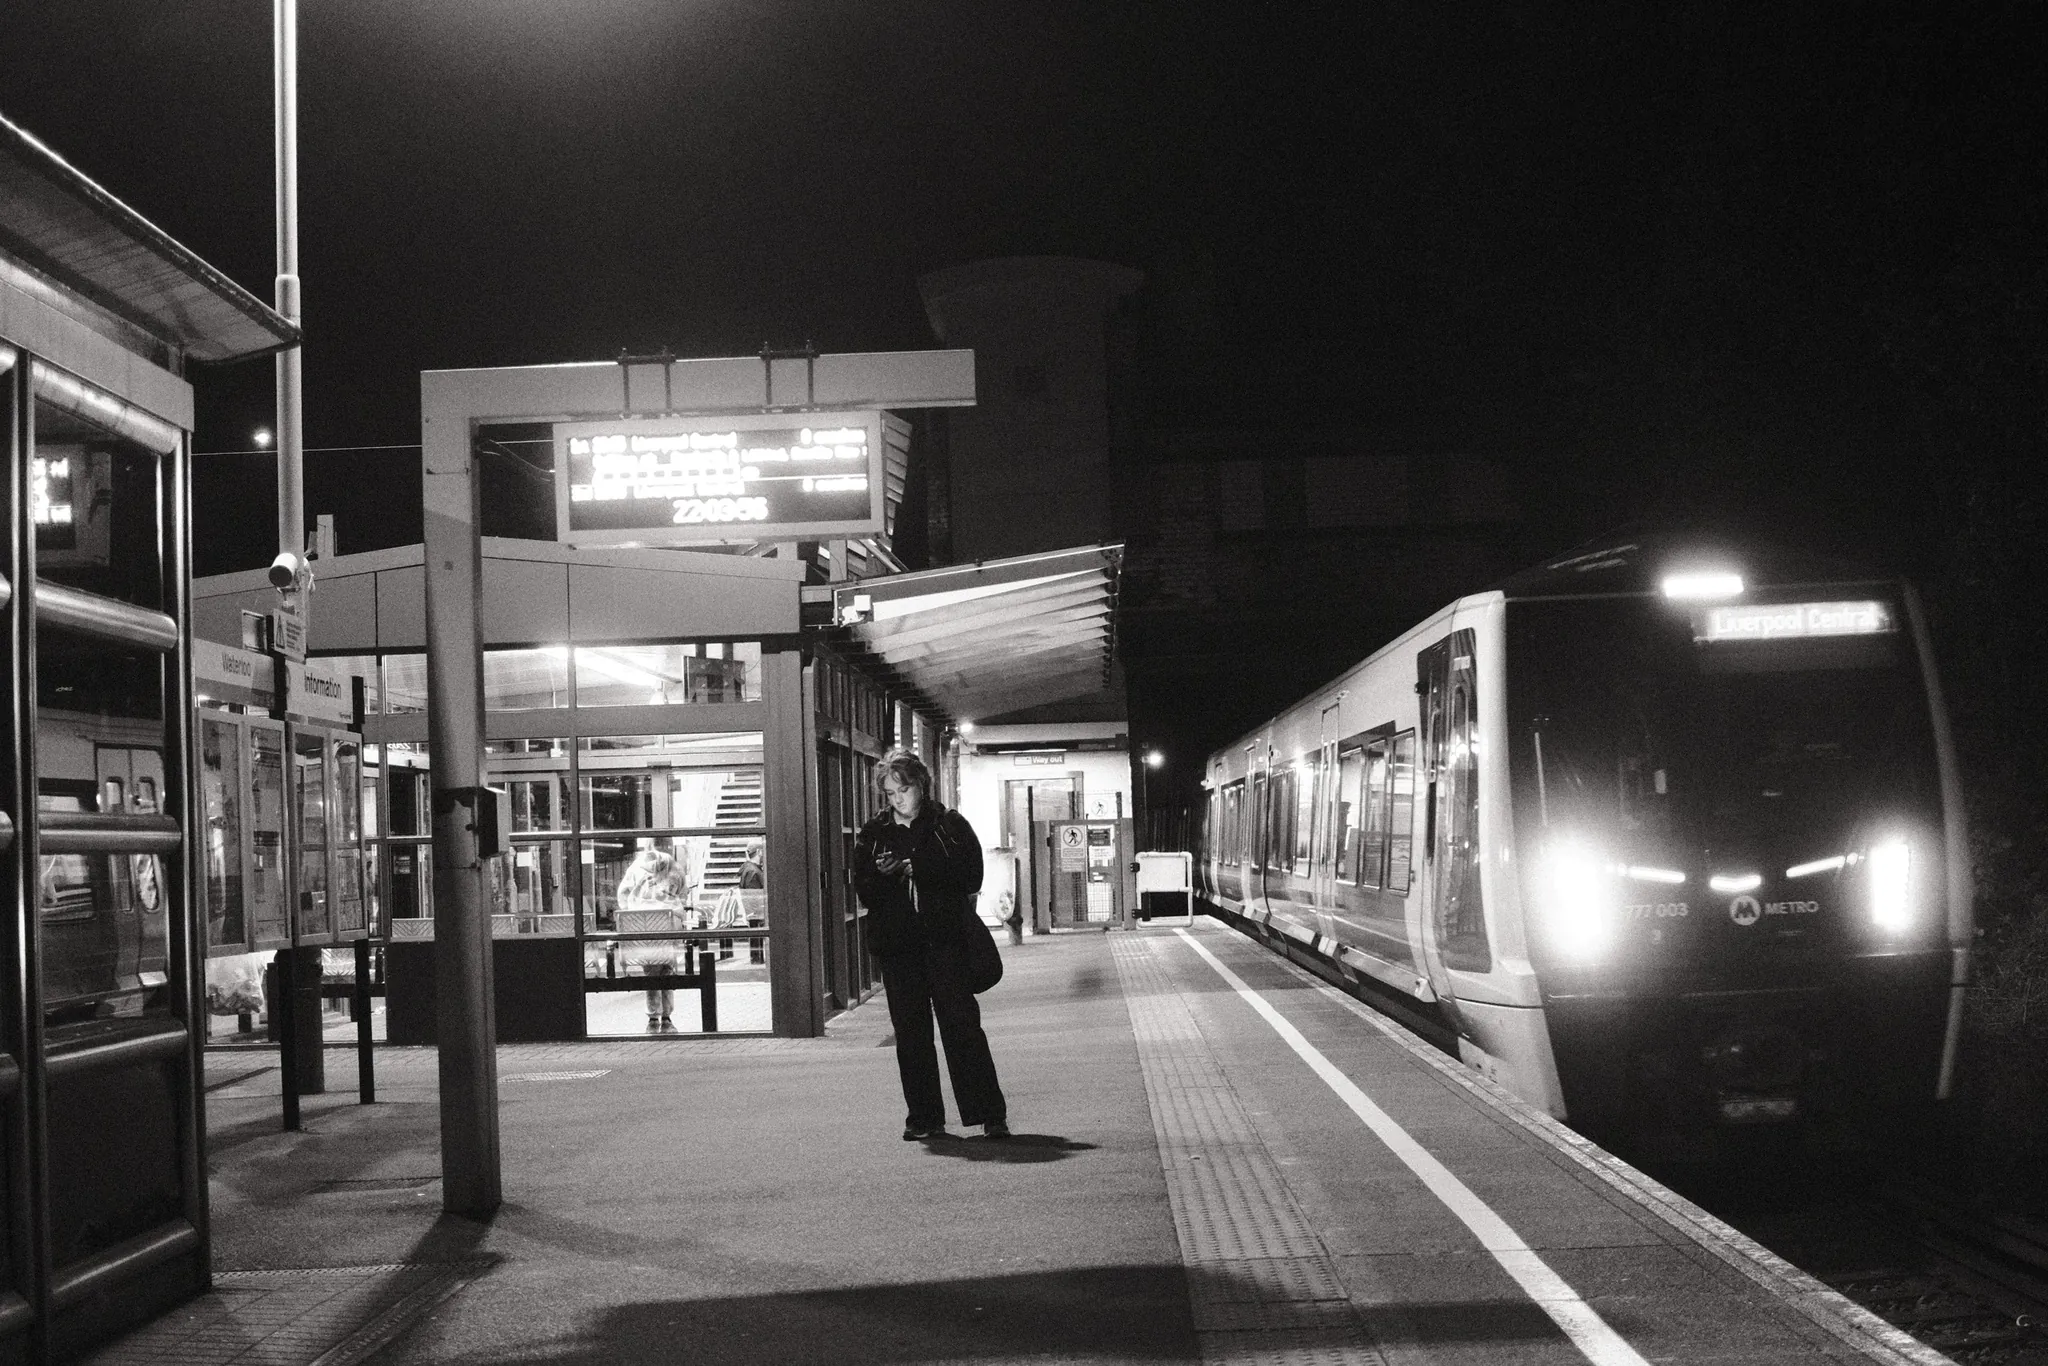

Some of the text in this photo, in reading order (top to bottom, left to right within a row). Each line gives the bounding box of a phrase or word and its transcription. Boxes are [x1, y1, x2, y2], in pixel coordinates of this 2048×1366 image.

[1716, 606, 1877, 635] Liverpool Central
[304, 672, 342, 699] Information
[1032, 755, 1063, 764] Way out
[1764, 900, 1819, 915] METRO
